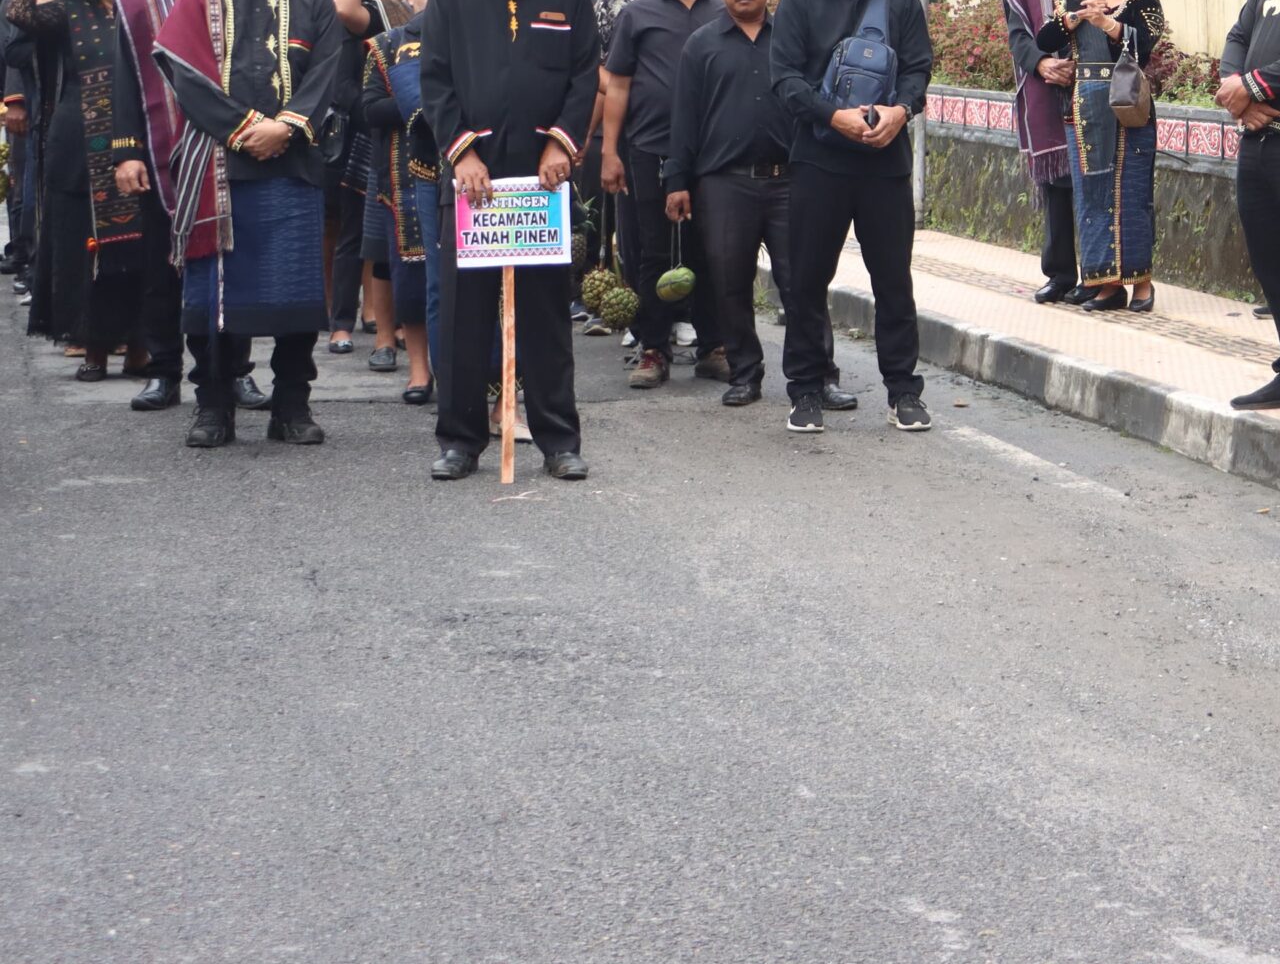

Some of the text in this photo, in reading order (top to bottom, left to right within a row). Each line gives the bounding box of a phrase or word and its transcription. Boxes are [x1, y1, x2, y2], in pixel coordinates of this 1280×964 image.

[471, 196, 549, 209] ONTINGEN
[473, 212, 547, 227] KECAMATAN
[462, 229, 558, 245] TANAH PINEM
